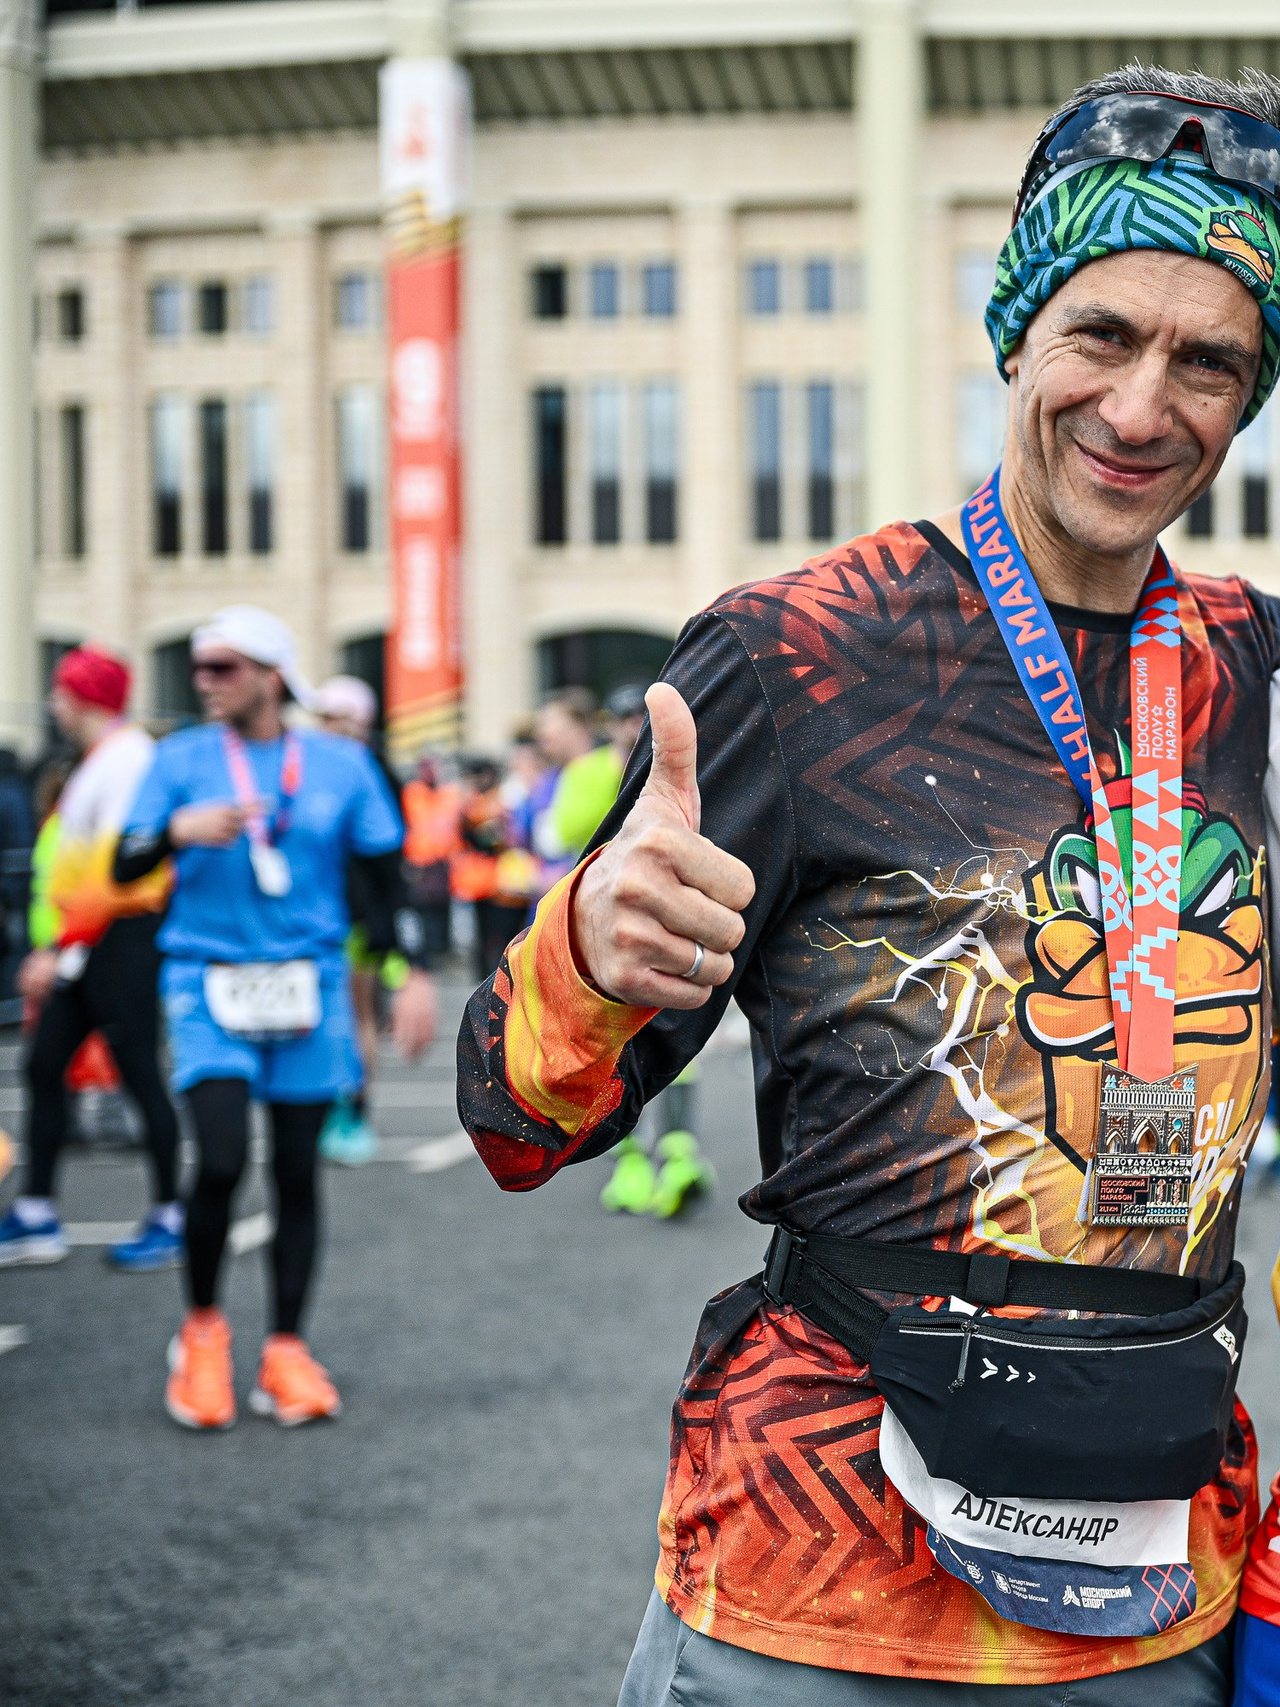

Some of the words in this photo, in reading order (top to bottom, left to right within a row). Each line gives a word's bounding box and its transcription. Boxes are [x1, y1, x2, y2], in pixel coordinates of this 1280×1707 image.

[1223, 258, 1258, 286] MYTISCHI
[967, 473, 1047, 646] MARATH
[1025, 654, 1091, 762] HALF
[1136, 656, 1149, 757] МОСКОВСКИЙ
[1165, 686, 1177, 760] МАРАФОН
[1151, 720, 1164, 759] ПОЛУ
[952, 1492, 1118, 1546] АЛЕКСАНДР
[1079, 1585, 1133, 1599] МОСКОВСКИЙ
[1081, 1598, 1106, 1609] СПОРТ
